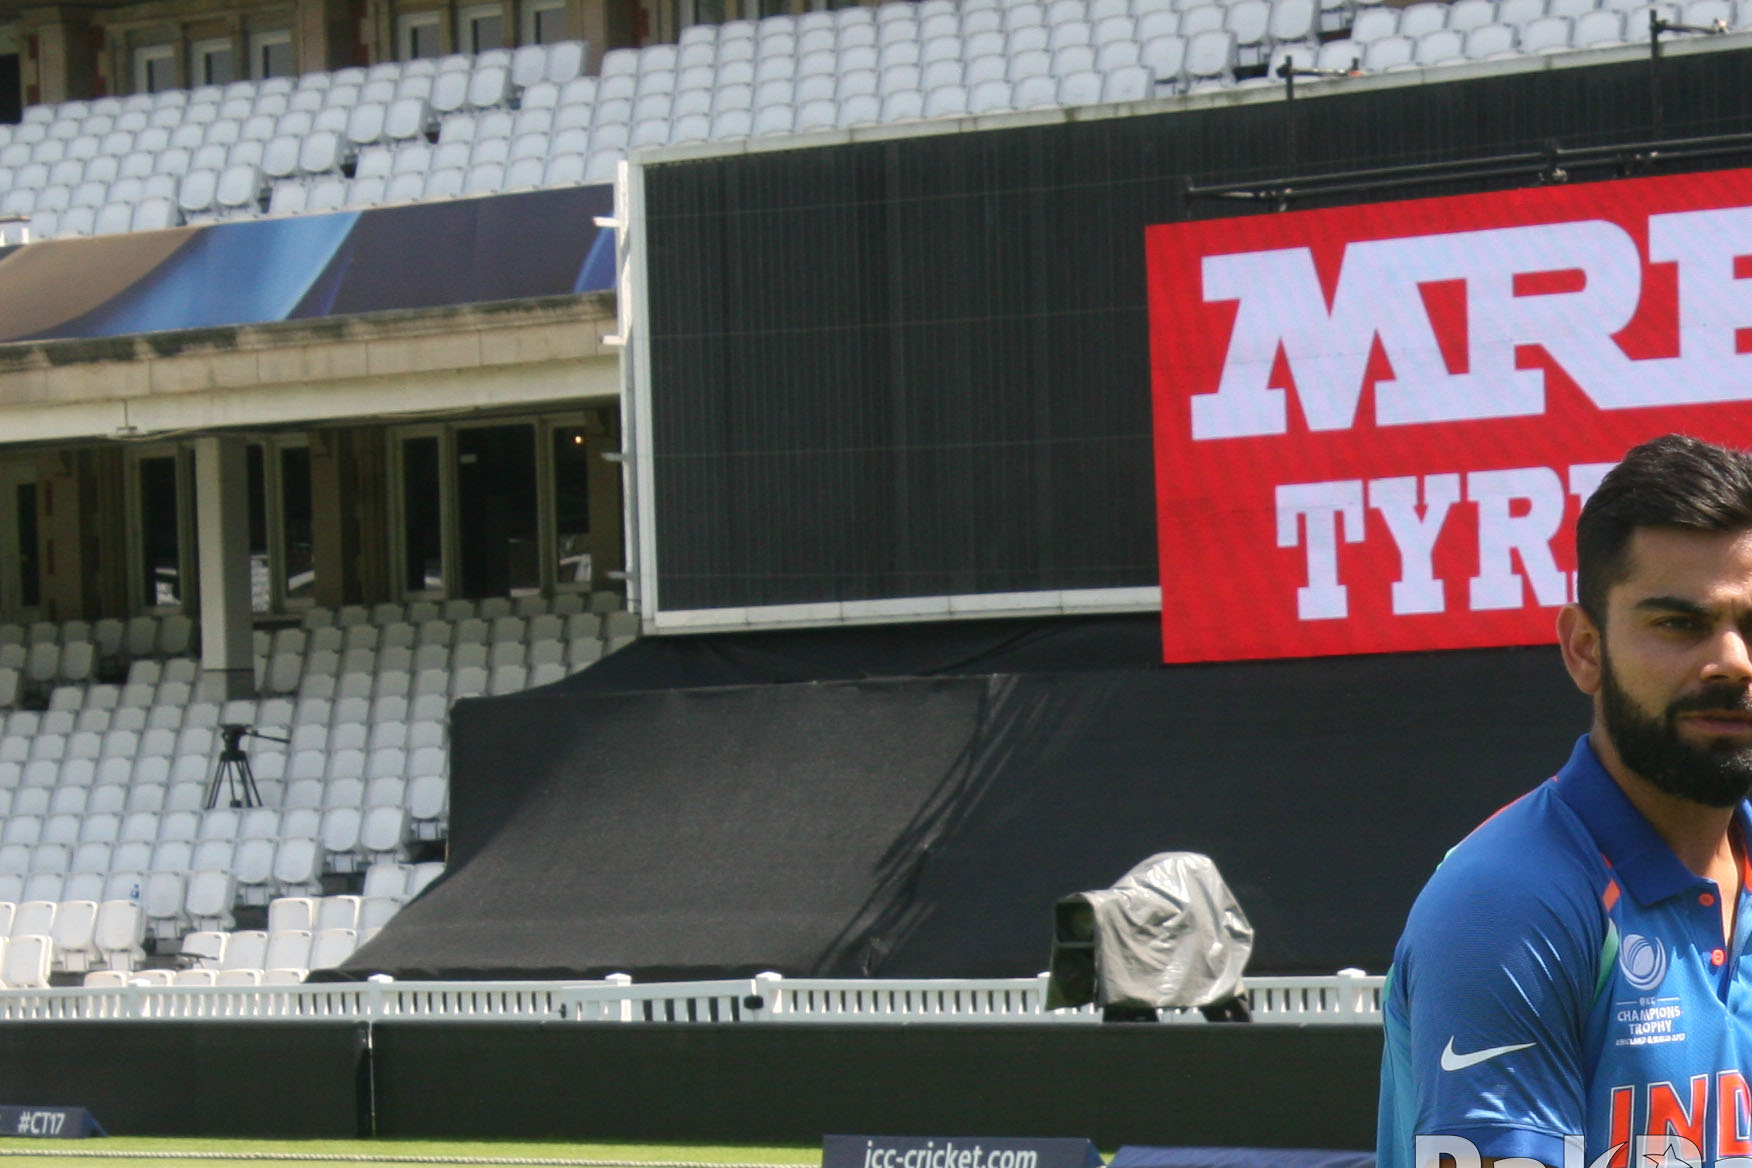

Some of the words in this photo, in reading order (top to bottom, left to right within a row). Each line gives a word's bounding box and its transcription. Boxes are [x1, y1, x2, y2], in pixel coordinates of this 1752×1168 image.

[1616, 1005, 1682, 1022] CHAMPIONS
[1629, 1020, 1673, 1036] TROPHY
[18, 1111, 66, 1136] #CT17
